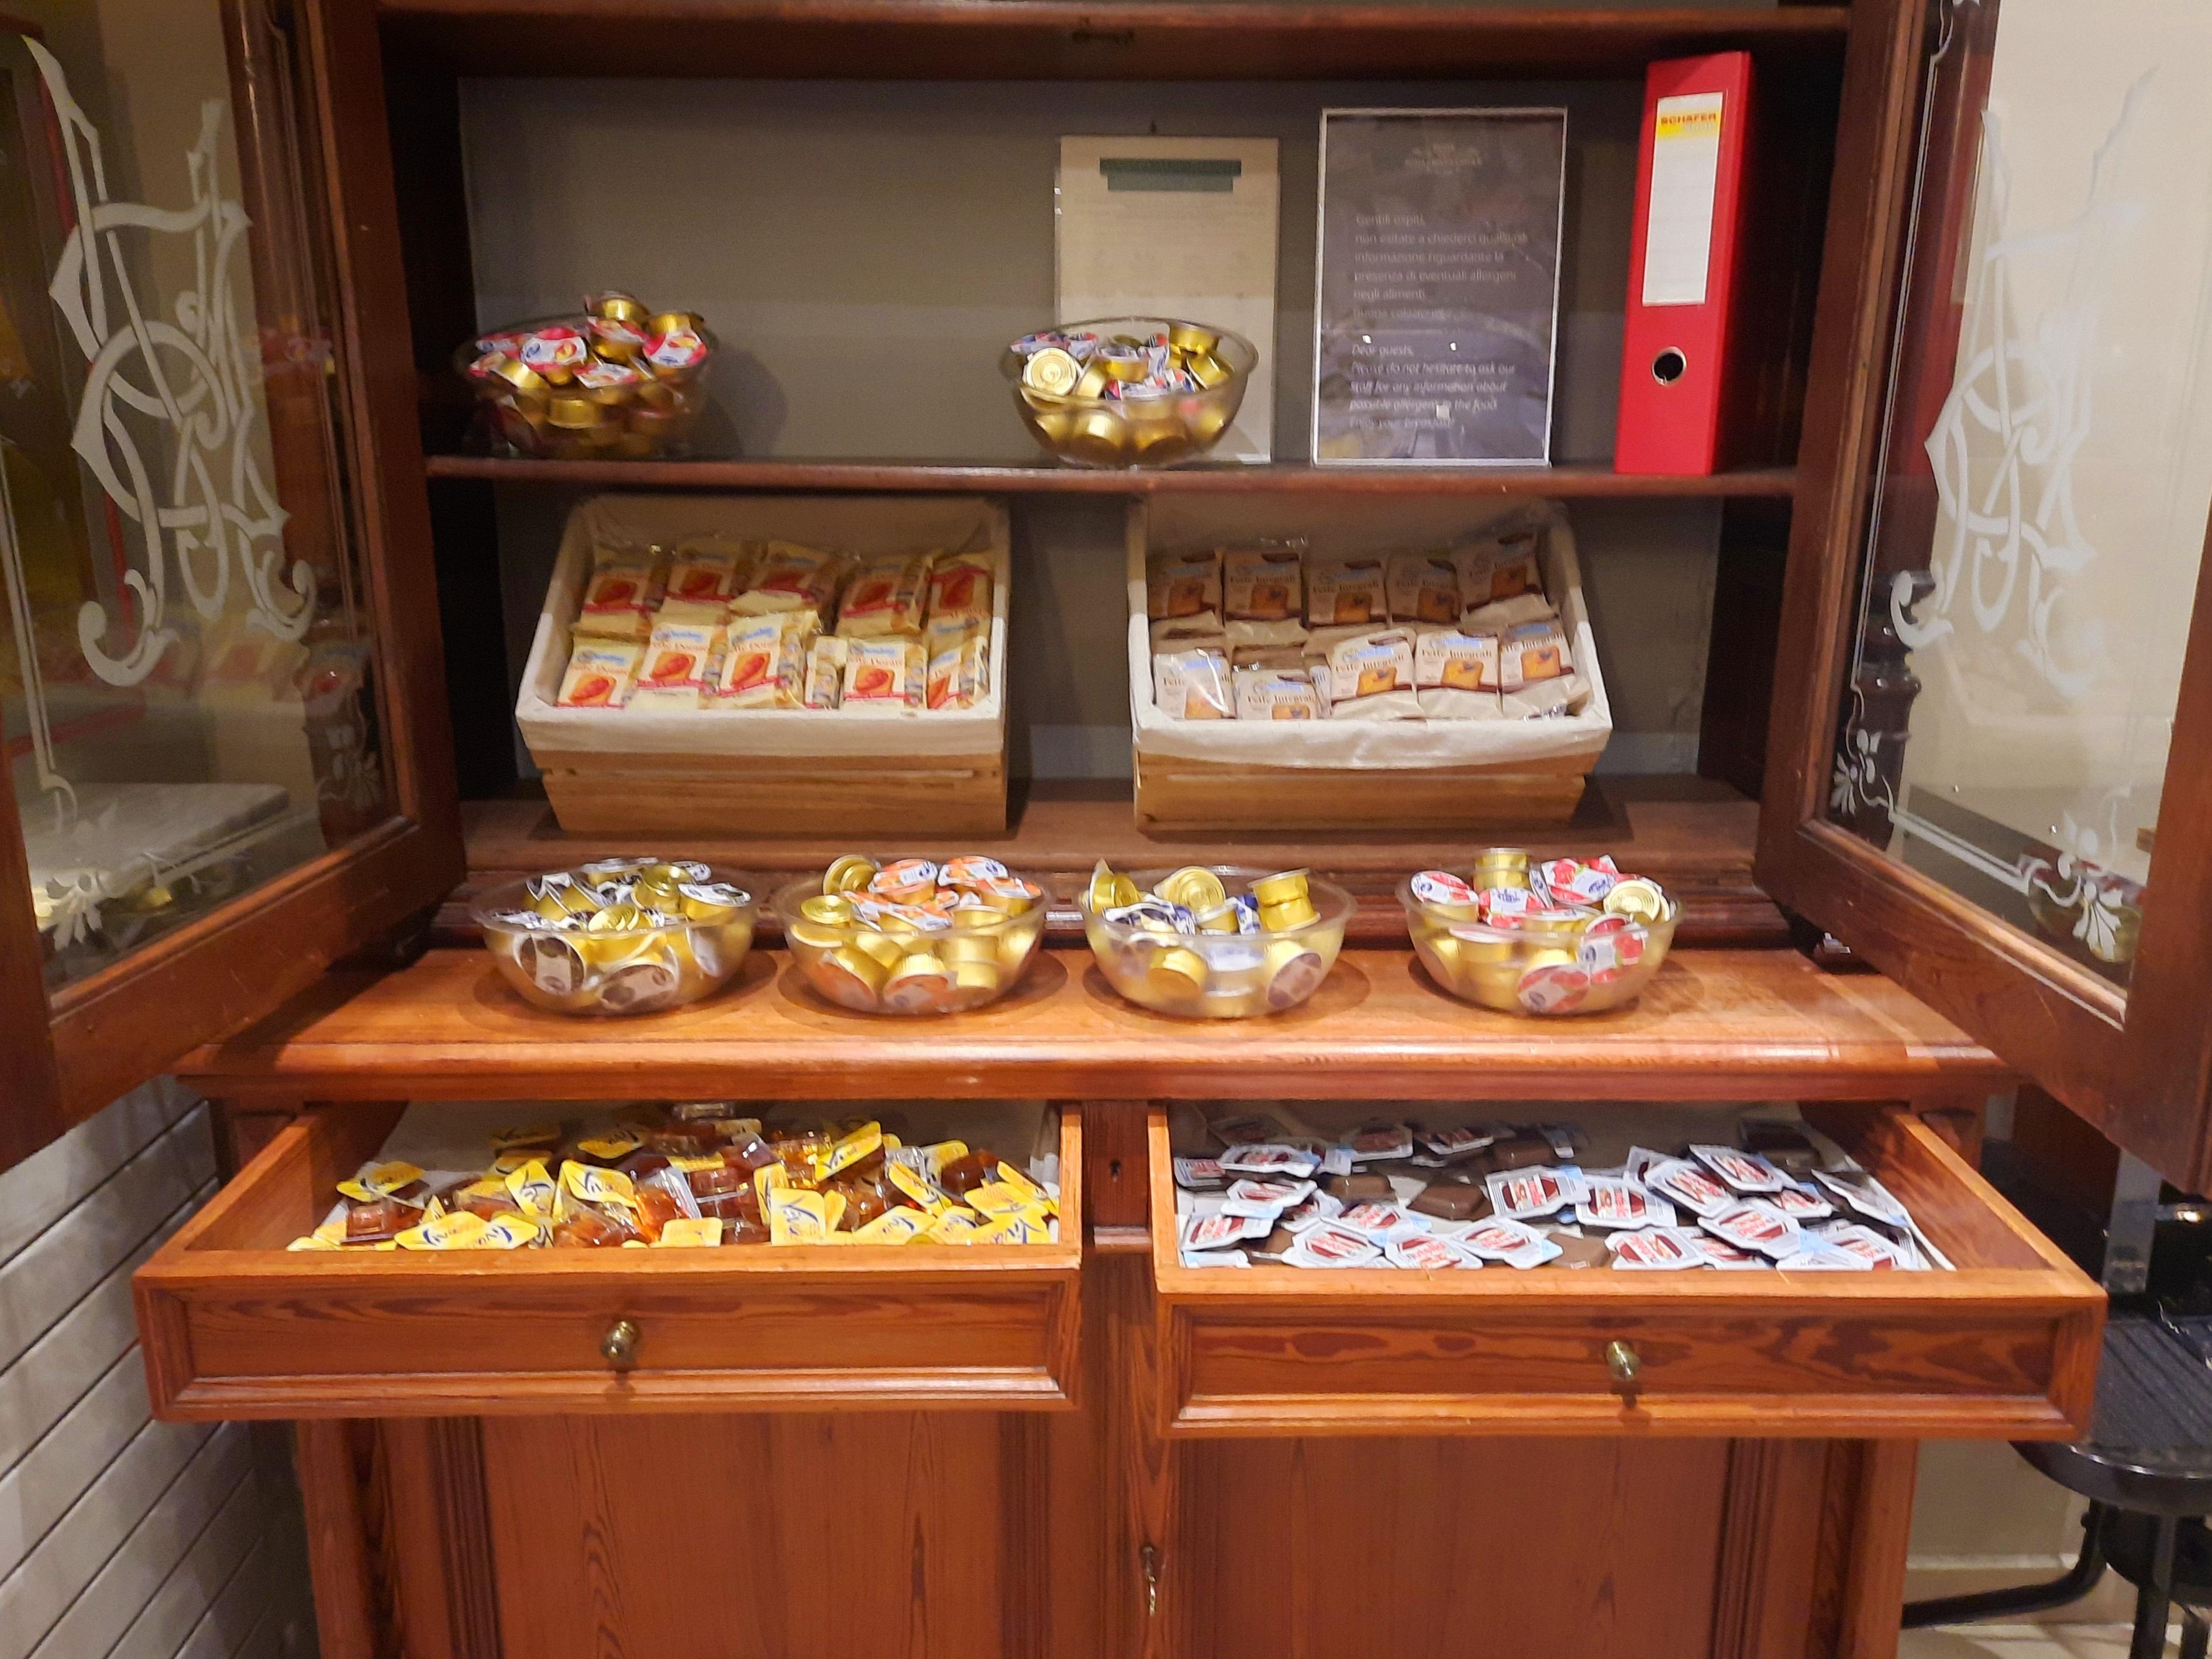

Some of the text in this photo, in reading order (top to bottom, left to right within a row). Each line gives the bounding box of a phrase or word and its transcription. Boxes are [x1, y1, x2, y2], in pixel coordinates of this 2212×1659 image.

[1356, 214, 1390, 225] Gentili
[1355, 234, 1376, 244] non
[1355, 251, 1425, 262] informazione
[1429, 252, 1491, 264] riguardante
[1353, 272, 1403, 283] presenza
[1406, 271, 1415, 280] di
[1419, 271, 1466, 281] eventuali
[1353, 288, 1380, 302] negli
[1387, 362, 1400, 374] do
[1403, 363, 1419, 374] not
